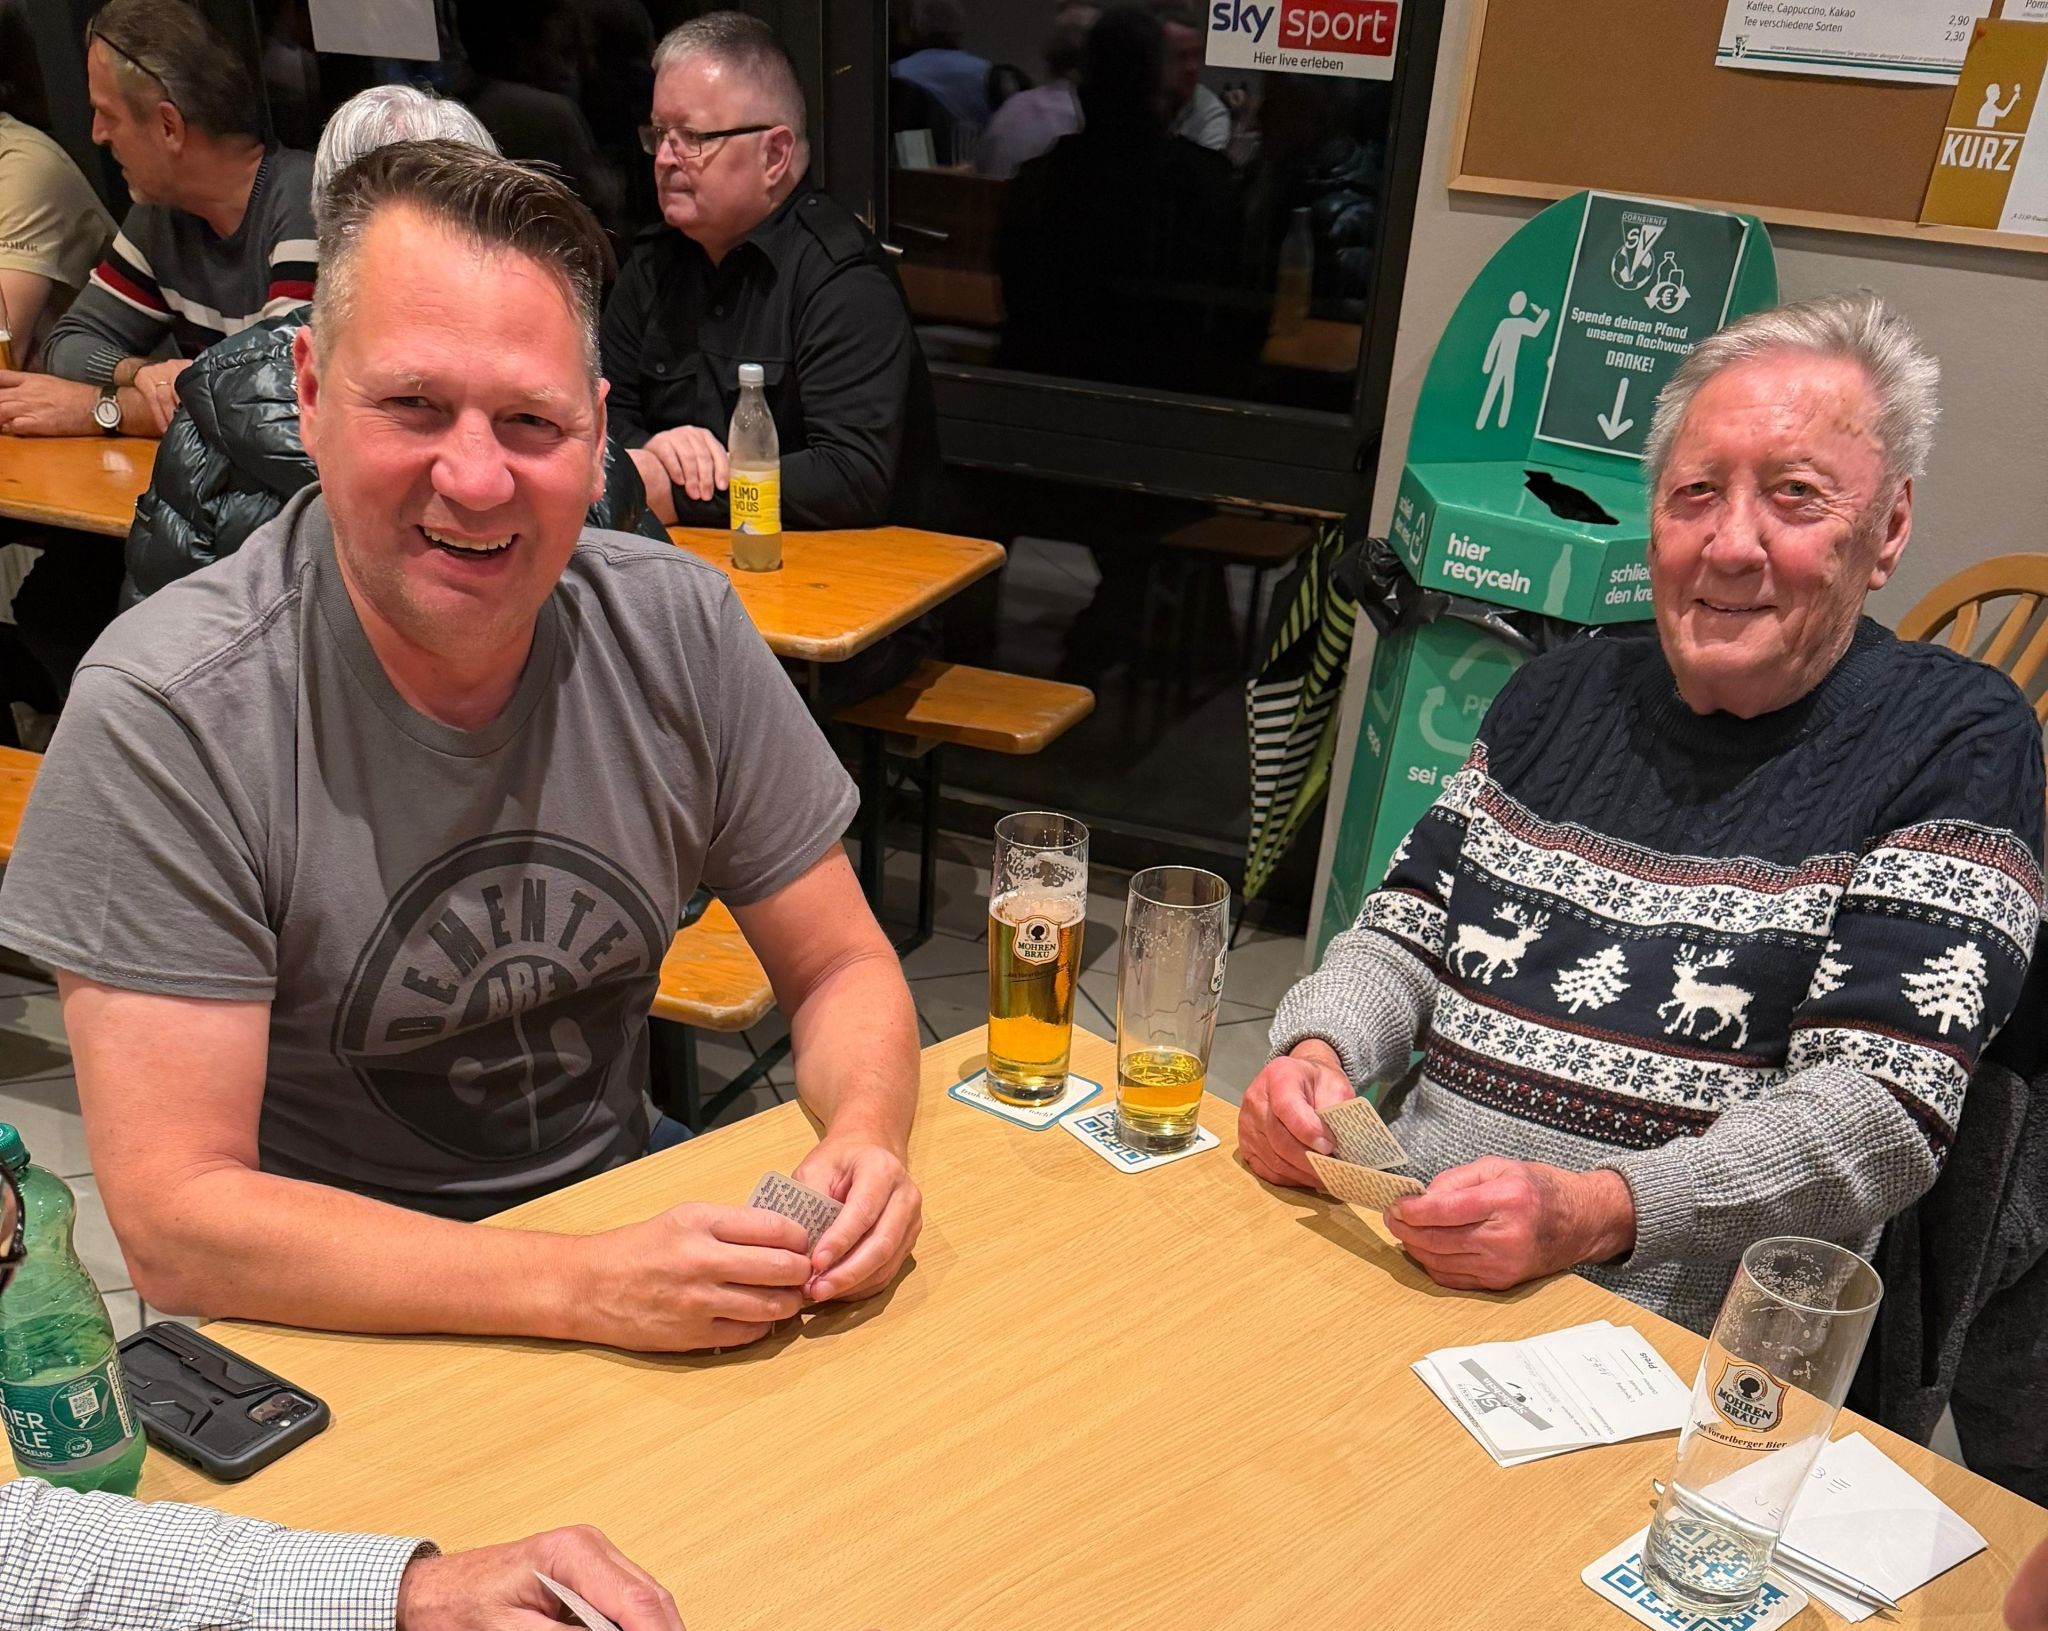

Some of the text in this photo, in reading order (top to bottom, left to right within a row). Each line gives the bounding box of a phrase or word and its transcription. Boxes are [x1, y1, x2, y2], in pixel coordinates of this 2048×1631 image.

[1212, 0, 1388, 46] sky sport
[1746, 1, 1970, 27] Kaffee, Cappuccino, Kakao 2,90
[1744, 16, 1965, 42] Tee verschiedene Sorten 2,30
[1253, 52, 1344, 71] Hier live erleben
[1940, 134, 2019, 171] KURZ
[1625, 228, 1657, 250] SV
[1571, 307, 1688, 339] Spende deinen Pfand
[1586, 327, 1634, 345] unserem
[1605, 350, 1655, 373] DANKE!
[734, 485, 759, 501] LIMO
[1448, 532, 1491, 563] hier
[1442, 559, 1531, 595] recyceln
[1605, 586, 1631, 605] den
[1408, 766, 1437, 785] sei
[1018, 942, 1056, 951] MOHREN
[1024, 950, 1049, 958] BRÄU
[488, 961, 557, 1018] ARE
[1640, 1352, 1658, 1369] Preis
[1483, 1377, 1528, 1415] Spielschein
[1717, 1387, 1773, 1420] MOHREN
[1722, 1402, 1760, 1426] BRÄU
[1708, 1427, 1764, 1448] Vorarlberger
